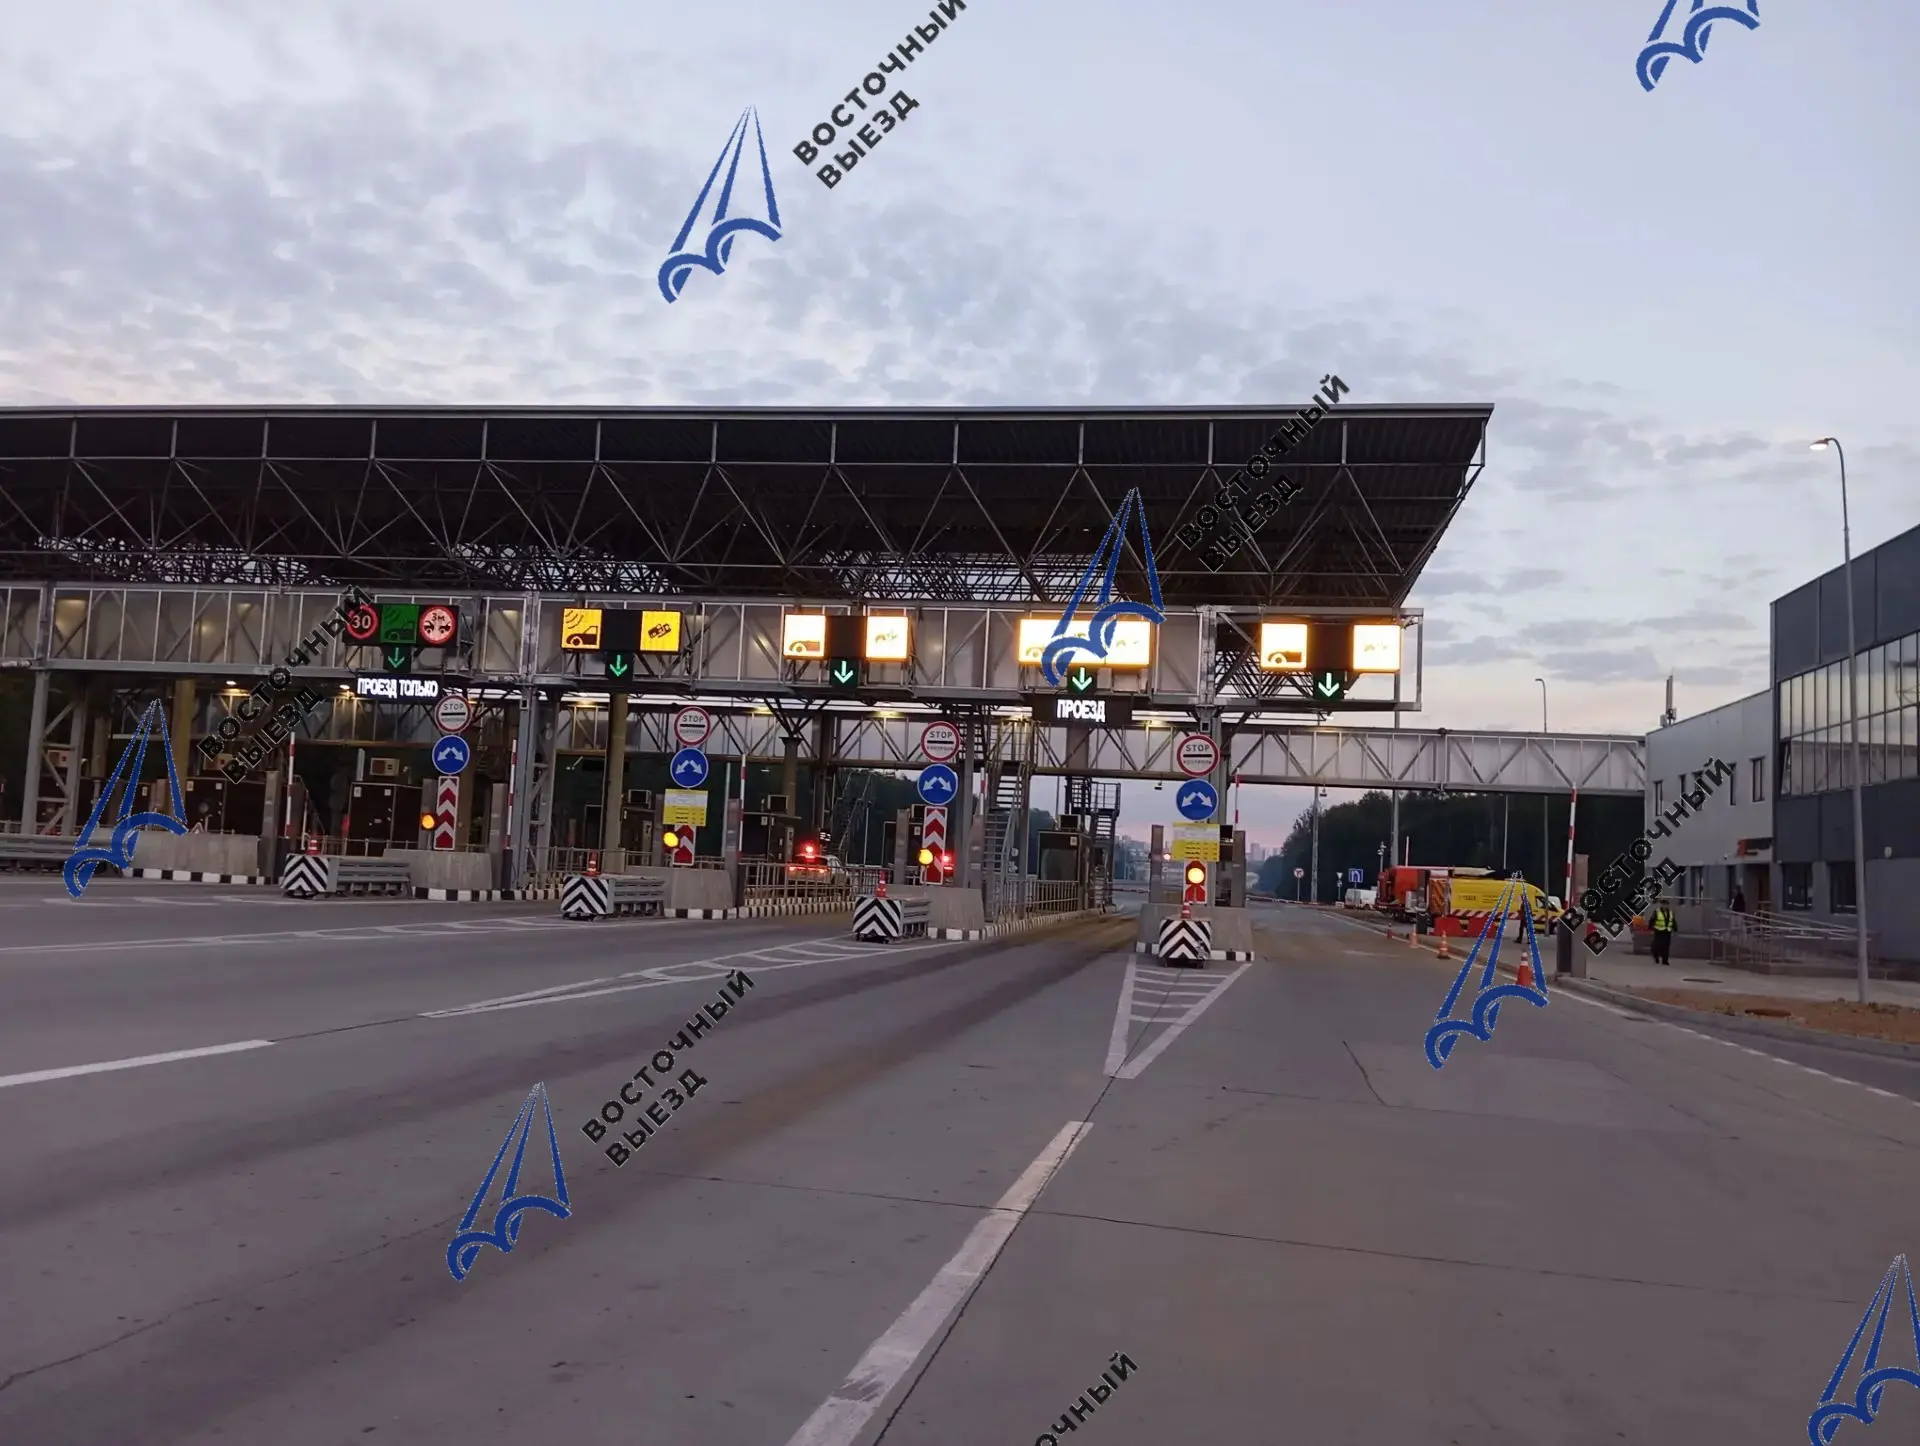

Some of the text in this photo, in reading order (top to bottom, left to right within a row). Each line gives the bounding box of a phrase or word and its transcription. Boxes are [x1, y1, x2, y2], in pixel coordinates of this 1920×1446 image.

[351, 614, 371, 629] 30
[357, 678, 438, 698] ПРОЕЗД ТОЛЬКО
[443, 703, 464, 711] STOP
[1057, 699, 1106, 723] ПРОЕЗД
[682, 714, 704, 723] STOP
[929, 731, 952, 739] STOP
[1185, 744, 1210, 752] STOP
